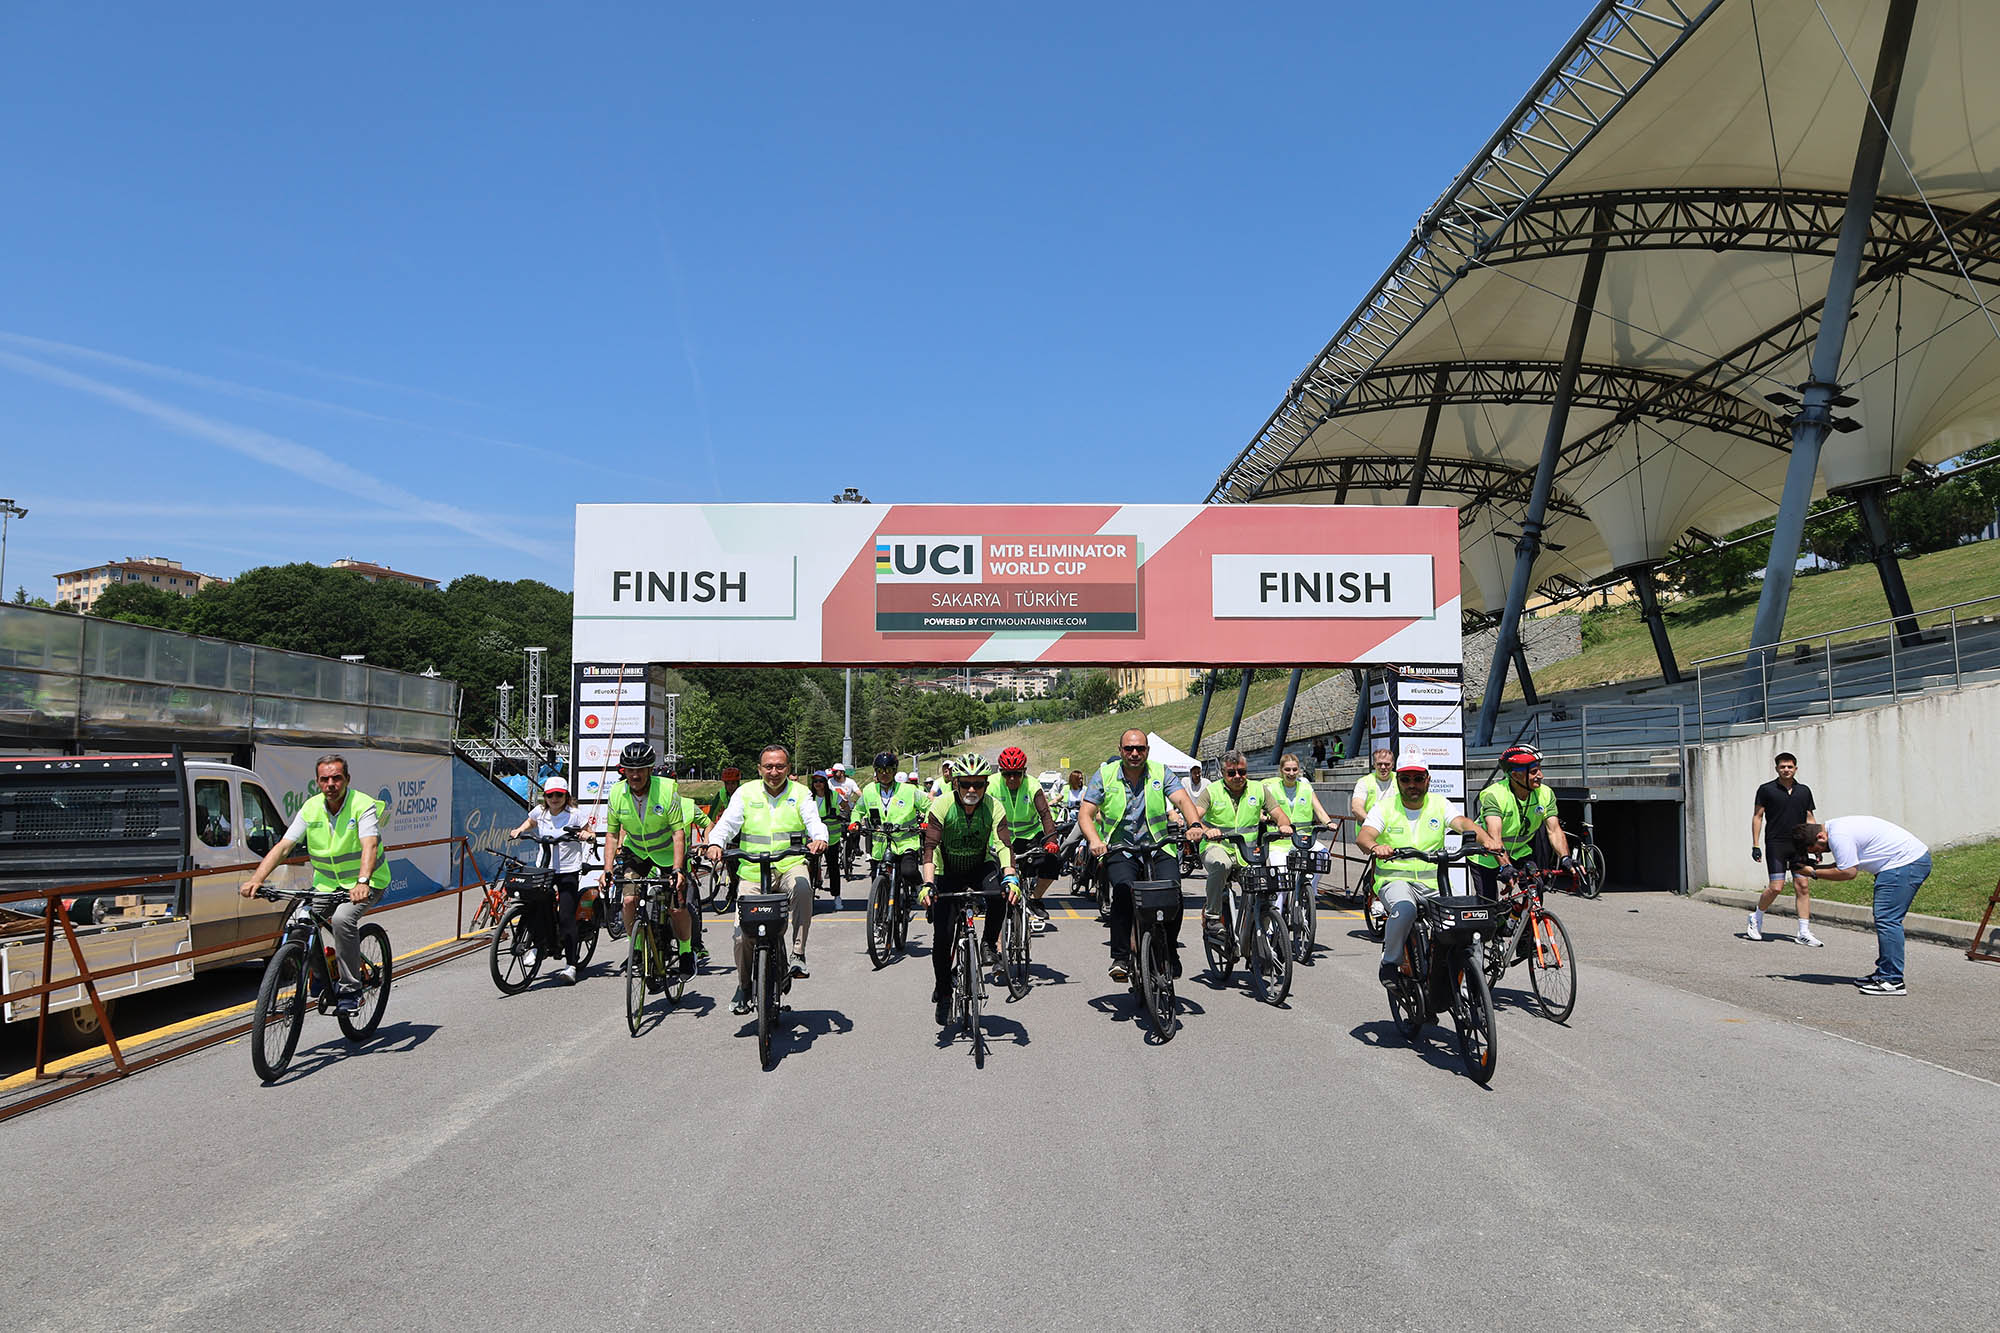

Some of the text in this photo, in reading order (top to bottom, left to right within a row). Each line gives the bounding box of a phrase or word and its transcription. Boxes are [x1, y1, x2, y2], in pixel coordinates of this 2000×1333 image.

[894, 544, 974, 575] UCI
[989, 544, 1127, 558] MTB ELIMINATOR
[989, 562, 1087, 575] WORLD CUP
[612, 571, 747, 602] FINISH
[1259, 572, 1391, 603] FINISH
[931, 589, 1079, 607] SAKARYA TÜRKİYE
[923, 617, 1087, 626] POWERED BY CITYMOUNTAINBIKE.COM
[1415, 667, 1458, 675] MOUNTAINBIKE
[397, 780, 426, 797] YUSUF
[395, 797, 438, 816] ALEMDAR
